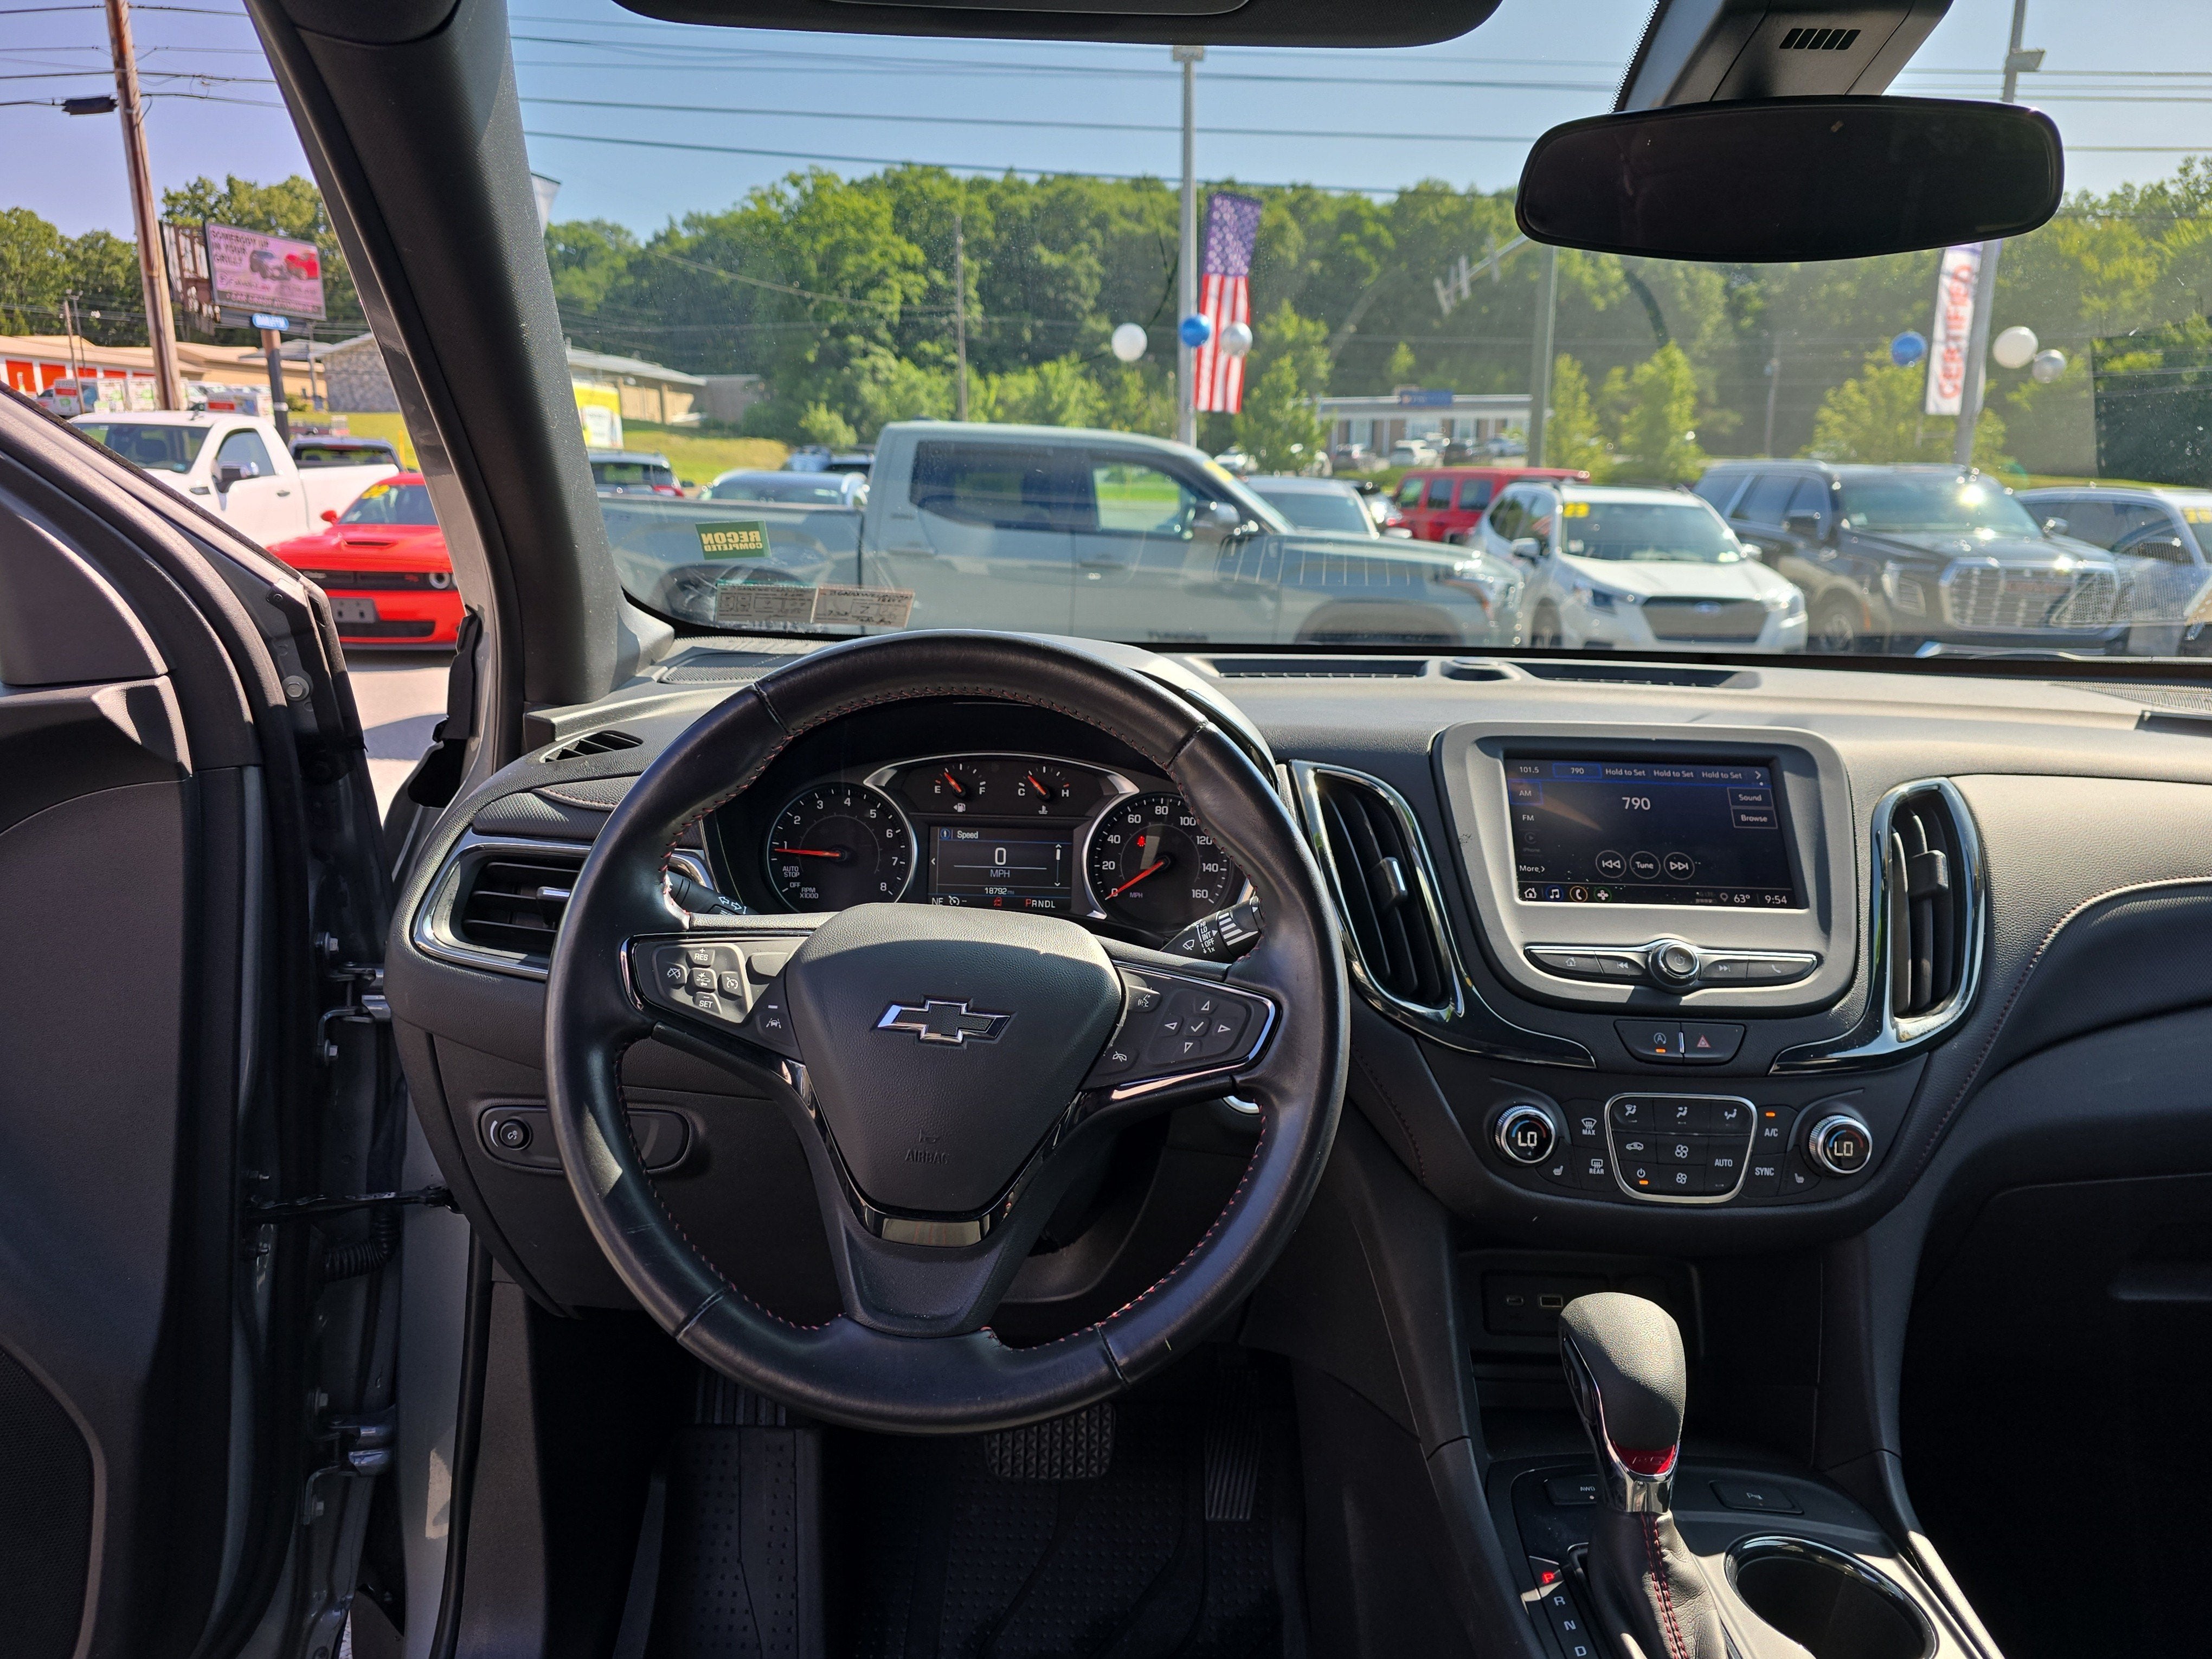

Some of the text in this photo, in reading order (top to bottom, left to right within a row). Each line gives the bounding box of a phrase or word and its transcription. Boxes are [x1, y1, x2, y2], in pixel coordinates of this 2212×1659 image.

[1654, 769, 1671, 777] Hold
[1730, 771, 1742, 780] Set
[934, 786, 941, 794] E
[979, 787, 986, 795] F
[1018, 788, 1025, 796] C
[844, 798, 851, 807] 4
[1738, 794, 1762, 802] Sound
[816, 800, 824, 809] 3
[1621, 796, 1651, 811] 790
[870, 809, 877, 818] 5
[1155, 806, 1168, 815] 80
[794, 815, 801, 825] 2
[1128, 814, 1141, 824] 60
[1180, 816, 1197, 826] 100
[1741, 814, 1767, 822] Browse
[886, 829, 893, 838] 6
[957, 830, 979, 840] Speed
[1107, 834, 1121, 844] 40
[1196, 835, 1212, 845] 120
[783, 841, 788, 850] 1
[994, 847, 1007, 865] 0
[892, 857, 898, 865] 7
[1102, 861, 1115, 870] 20
[1635, 861, 1654, 869] Tune
[1202, 863, 1219, 872] 140
[990, 869, 1010, 878] MPH
[880, 882, 887, 891] 8
[1192, 889, 1208, 898] 160
[1765, 895, 1787, 904] 9:54
[1200, 925, 1208, 934] LO
[1201, 931, 1211, 941] INT
[1204, 937, 1214, 948] OFF
[695, 953, 709, 961] RES
[699, 1000, 713, 1008] SET
[1764, 1128, 1778, 1137] A/C
[1518, 1131, 1537, 1147] LO
[1834, 1141, 1853, 1156] LO
[904, 1148, 950, 1165] AIRBAG
[1714, 1158, 1733, 1167] AUTO
[1754, 1167, 1774, 1176] SYNC
[1543, 1572, 1555, 1583] P
[1554, 1596, 1566, 1606] R
[1564, 1620, 1576, 1631] N
[1574, 1645, 1587, 1657] D
